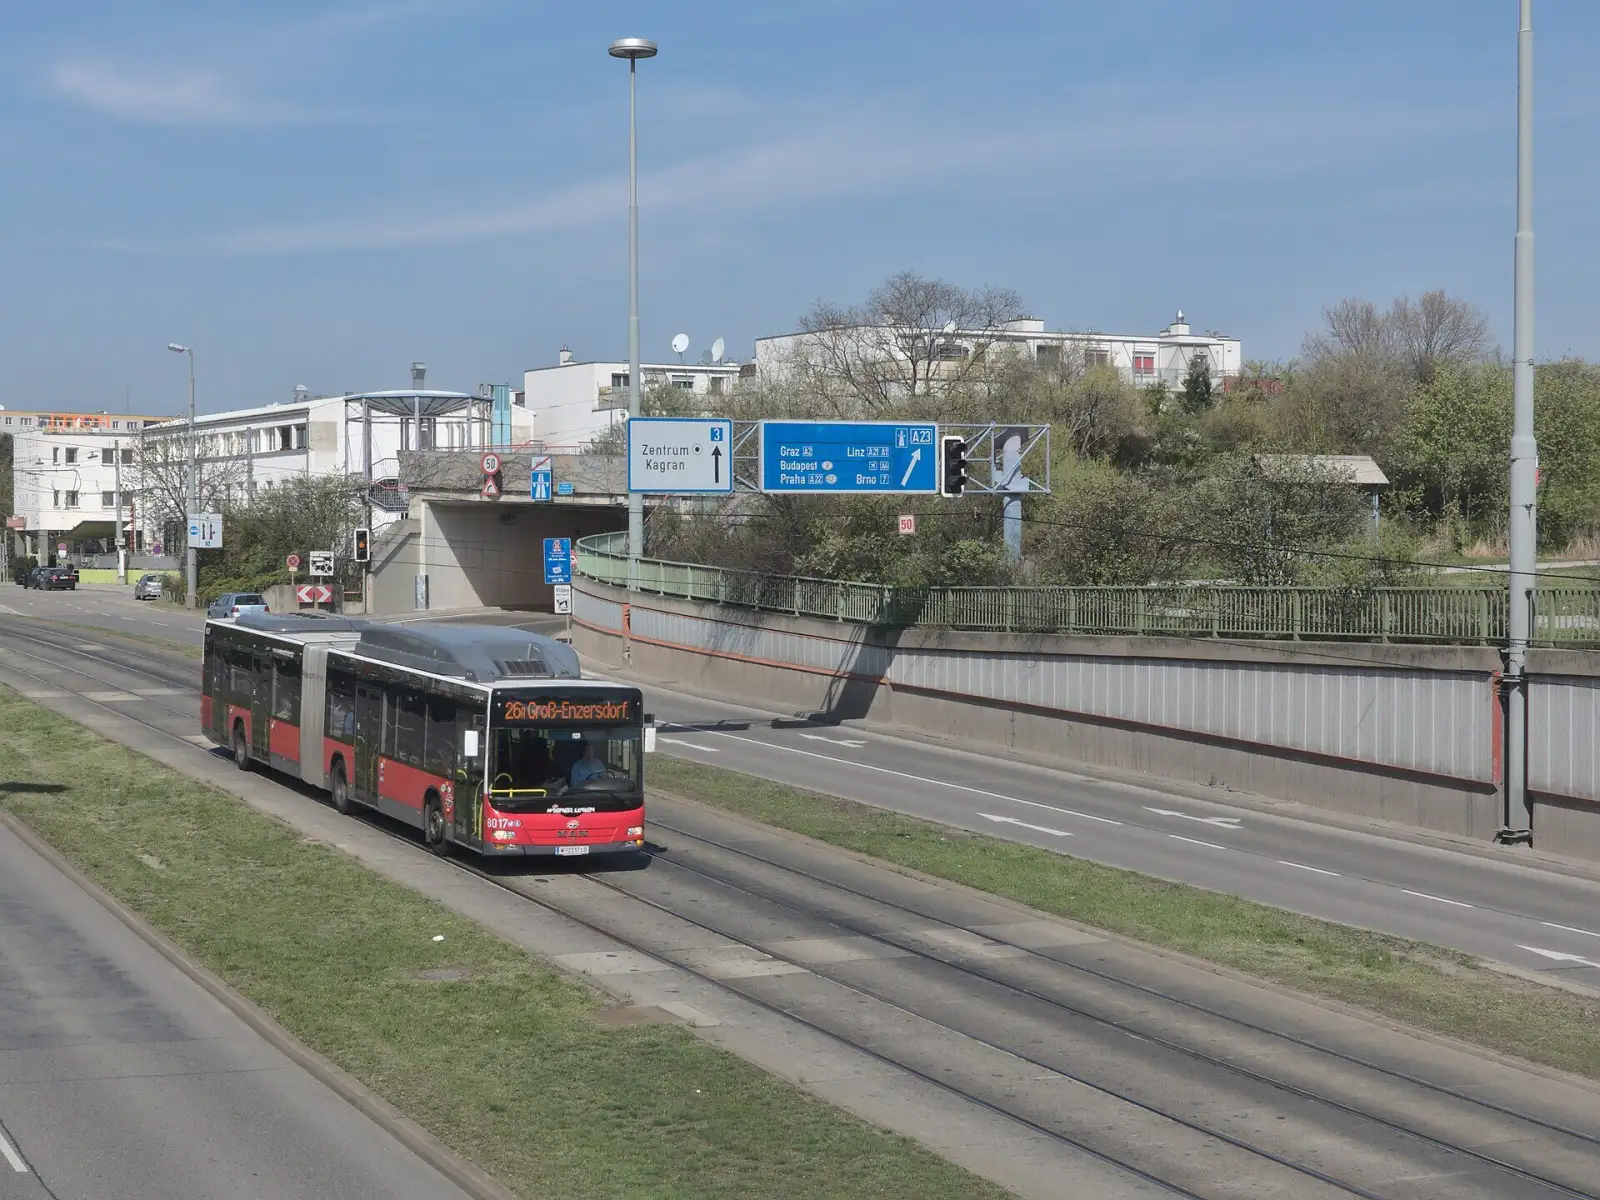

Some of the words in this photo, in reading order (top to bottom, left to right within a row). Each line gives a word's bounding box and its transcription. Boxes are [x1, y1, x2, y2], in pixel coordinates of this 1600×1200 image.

[713, 428, 720, 441] 3
[912, 430, 931, 442] A23
[642, 444, 689, 455] Zentrum
[780, 445, 800, 457] Graz
[847, 446, 865, 457] Linz
[486, 458, 496, 469] 50
[646, 459, 685, 472] Kagran
[780, 460, 818, 472] Budapest
[780, 473, 806, 484] Praha
[809, 474, 822, 484] A22
[856, 474, 877, 484] Brno
[901, 519, 912, 530] 50
[527, 701, 628, 720] Groß-Enzersdorf
[487, 818, 508, 829] 8017
